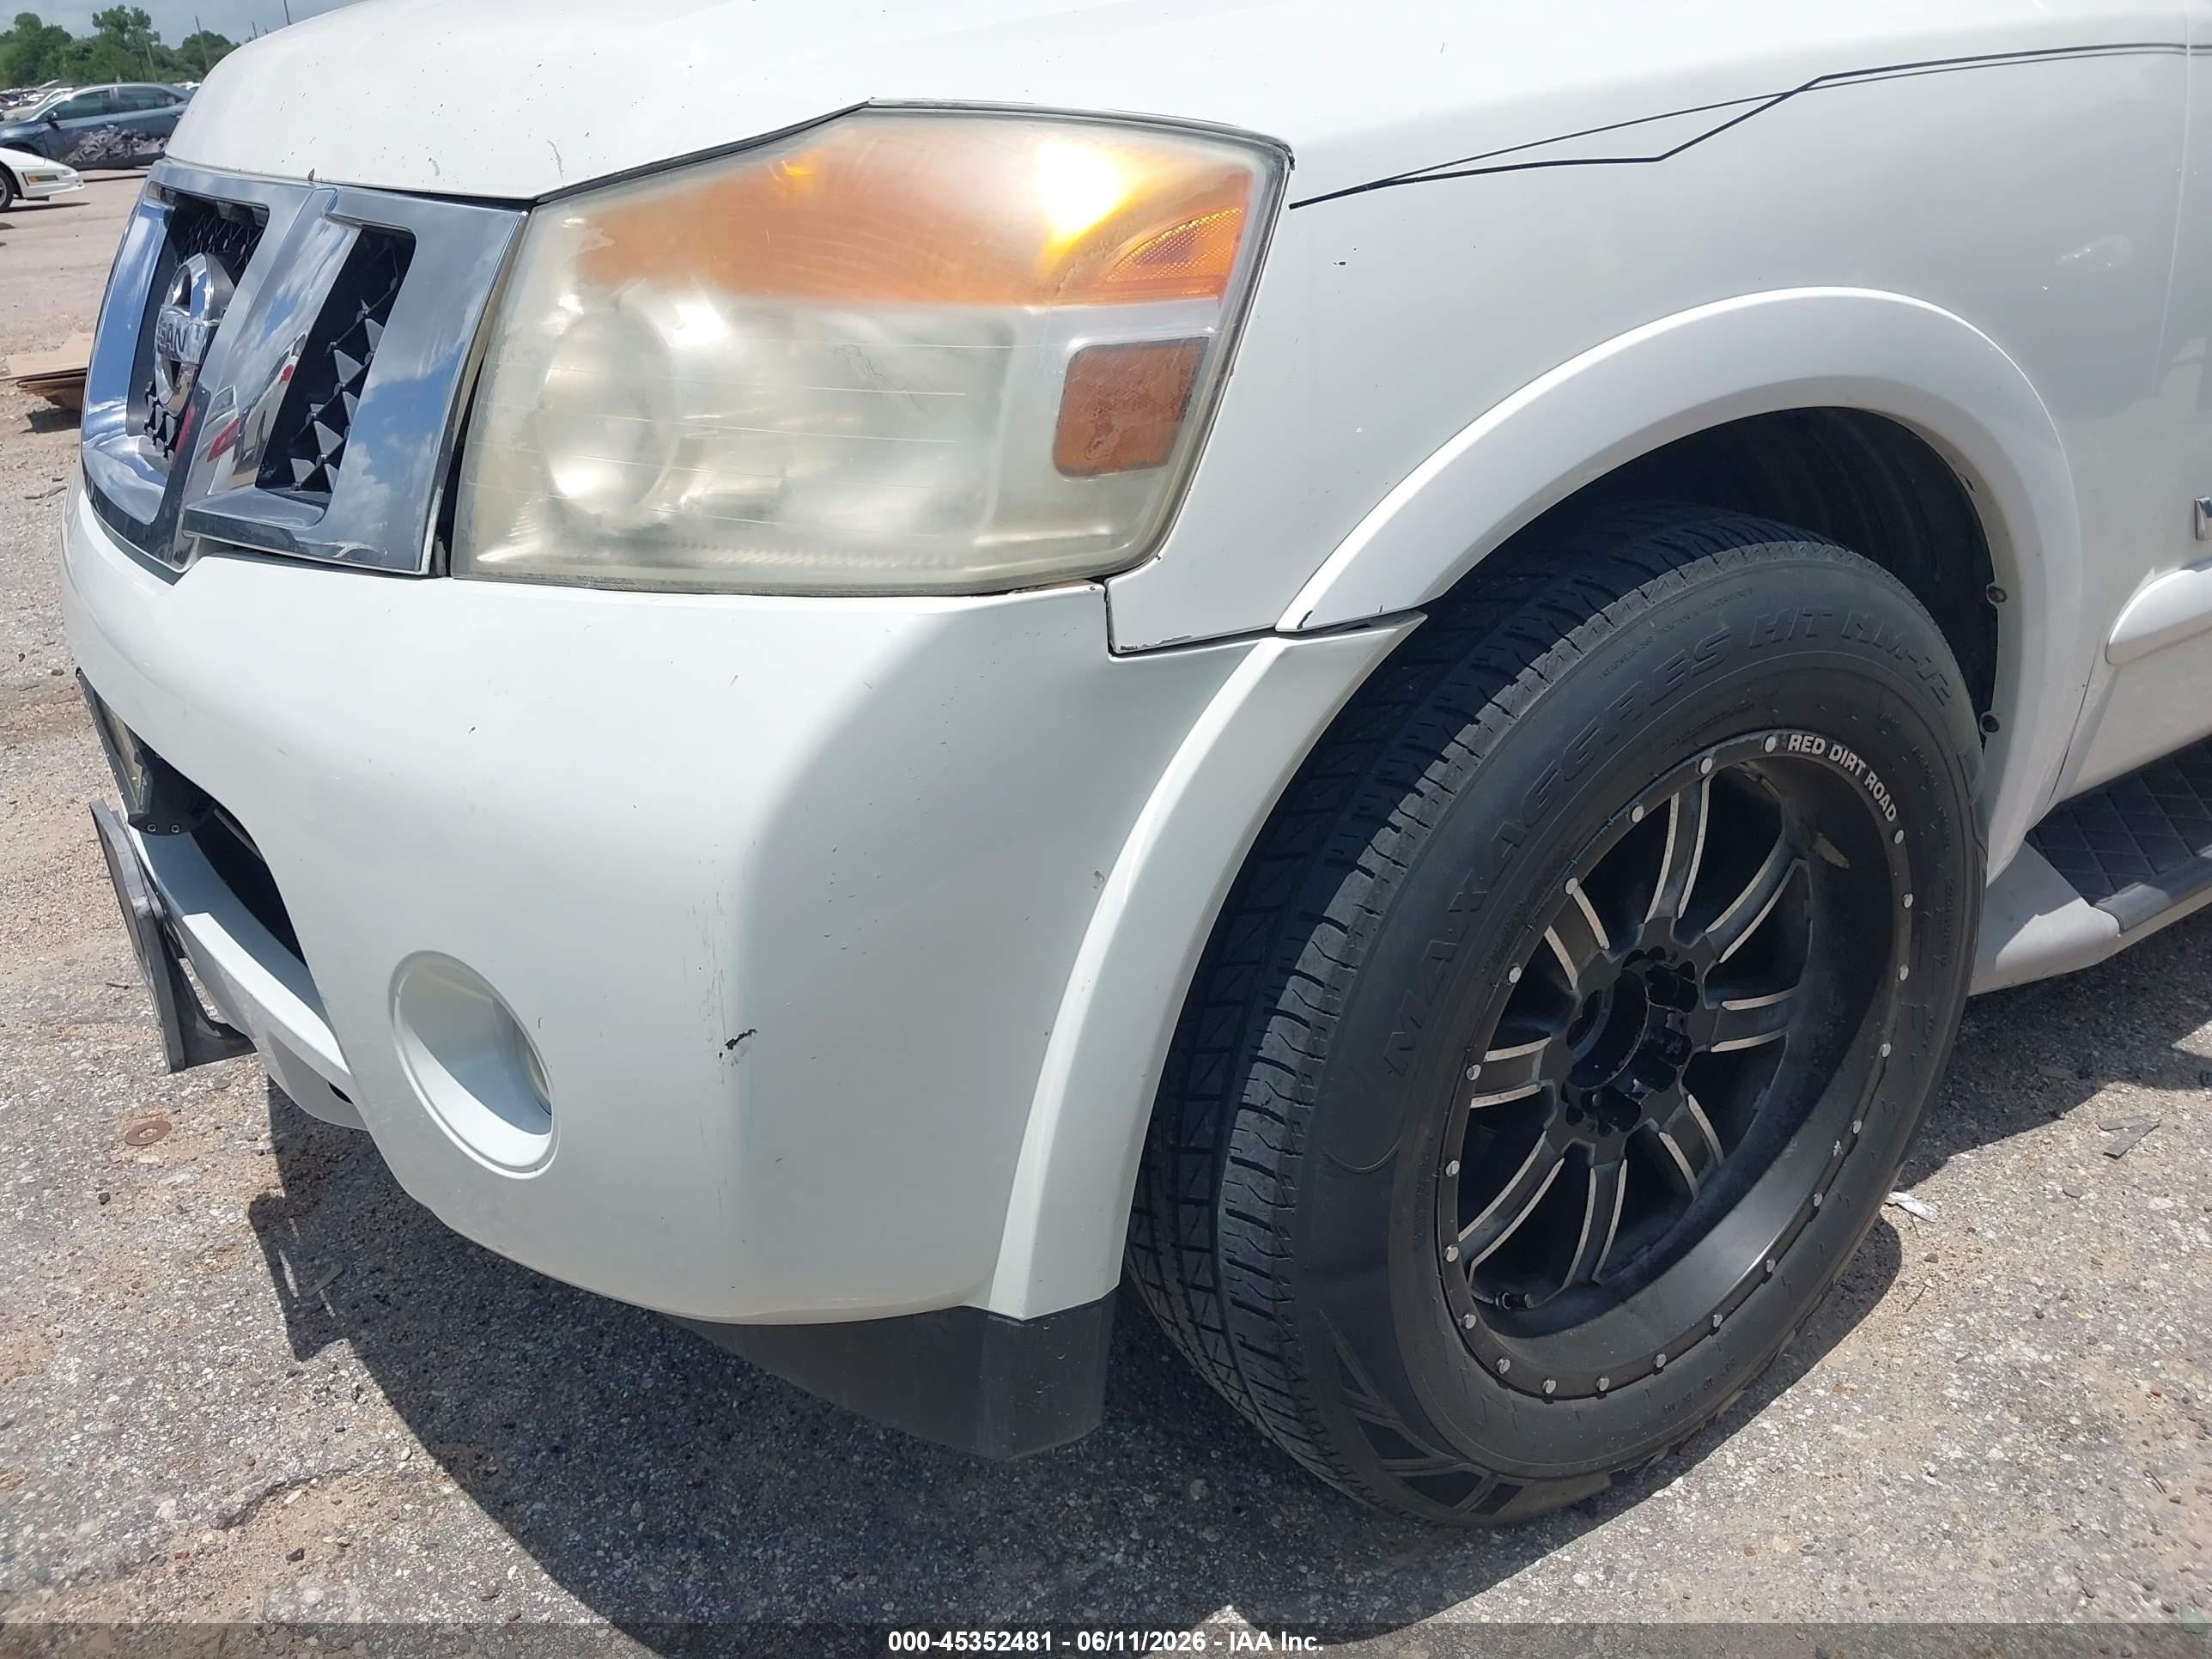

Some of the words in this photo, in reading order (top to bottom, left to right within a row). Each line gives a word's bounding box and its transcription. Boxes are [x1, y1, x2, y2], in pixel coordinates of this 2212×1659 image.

[1787, 734, 1826, 756] RED
[1828, 744, 1866, 777] DIRT
[1863, 770, 1897, 823] ROAD
